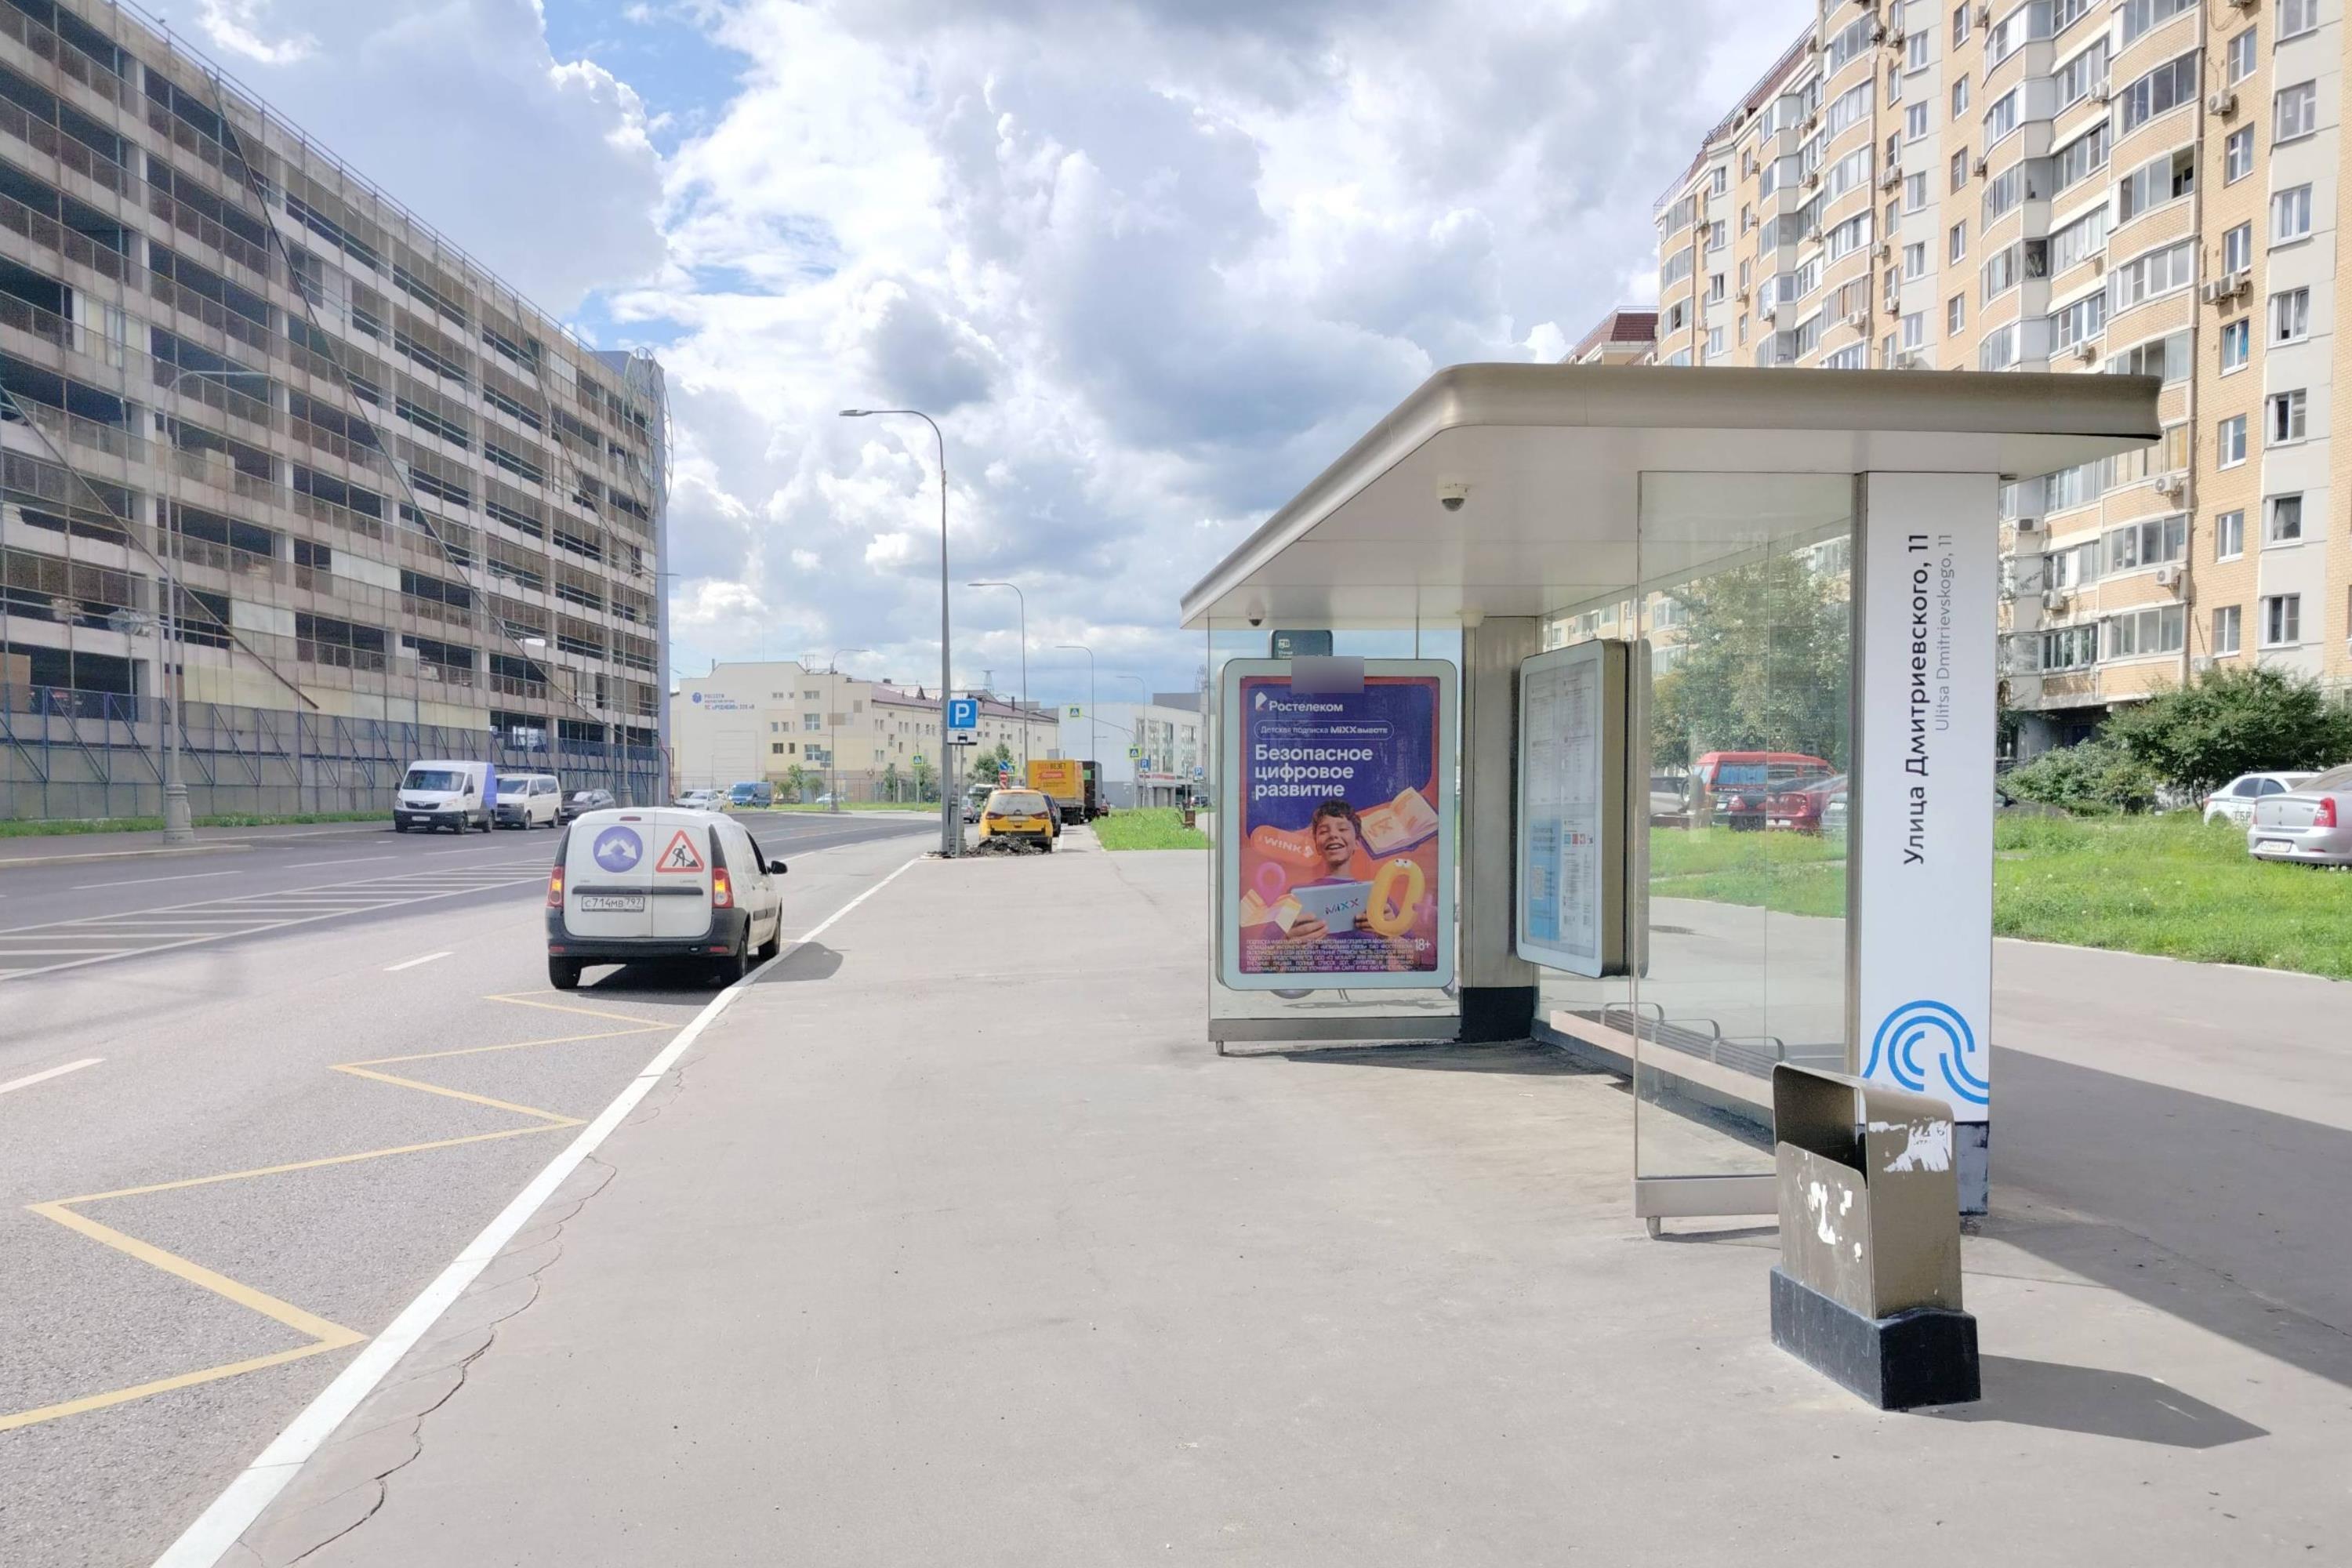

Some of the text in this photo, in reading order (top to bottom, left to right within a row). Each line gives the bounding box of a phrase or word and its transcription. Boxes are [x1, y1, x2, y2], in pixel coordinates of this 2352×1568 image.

[1935, 535, 1955, 731] Ulitsa Dmitrievskogo, 11
[1269, 700, 1344, 713] Ростелеком
[1903, 535, 1933, 866] Улица Дмитриевского, 11
[1255, 744, 1373, 760] Безопасное
[1255, 763, 1354, 782] цифровое
[1255, 785, 1345, 800] развитие
[1414, 938, 1431, 951] 18+
